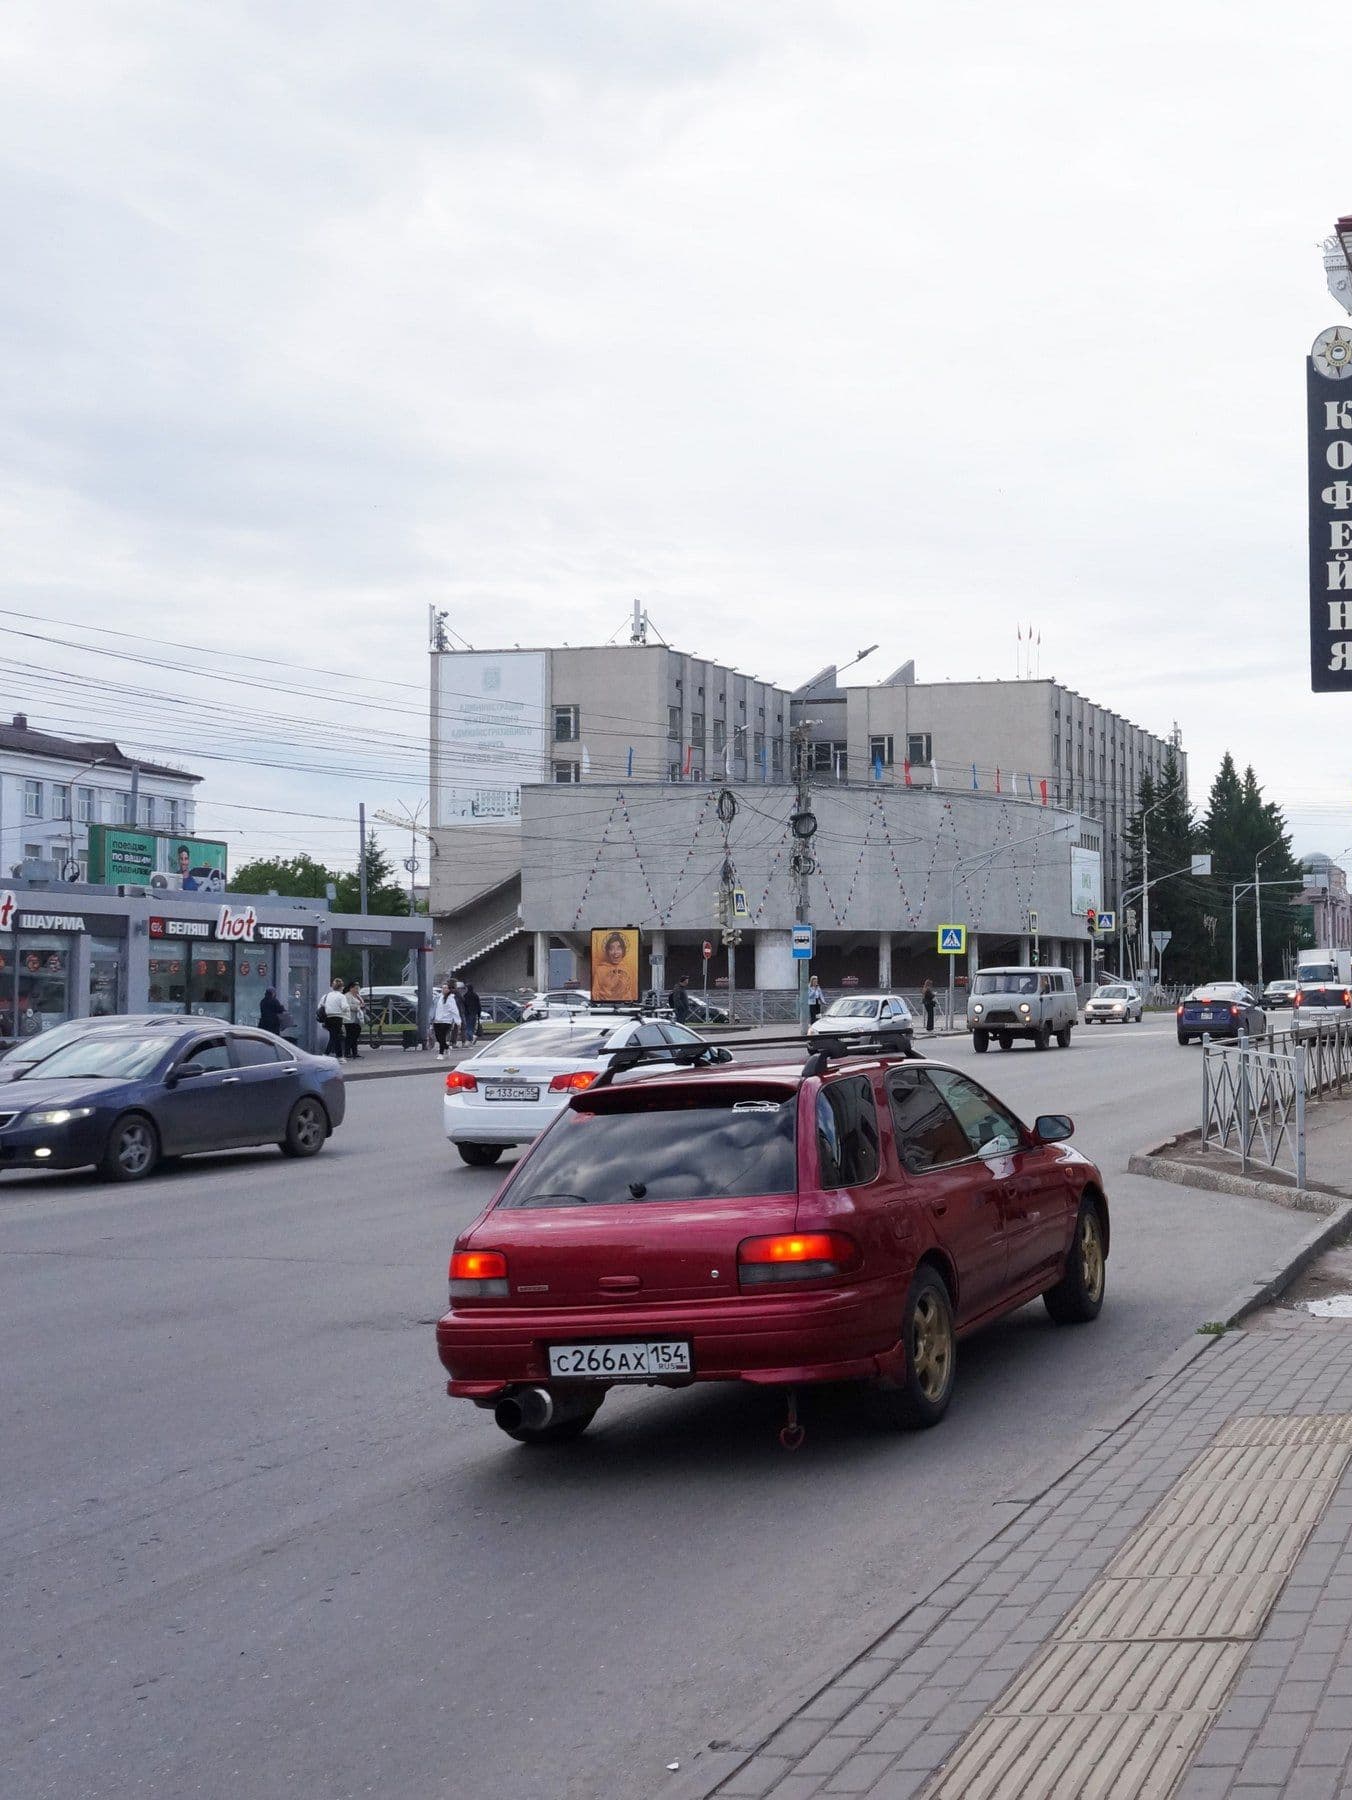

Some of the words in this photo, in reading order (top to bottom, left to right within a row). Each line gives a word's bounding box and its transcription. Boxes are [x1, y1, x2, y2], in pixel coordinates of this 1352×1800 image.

[20, 914, 87, 931] ШАУРМА
[167, 921, 210, 936] БЕЛЯШ
[259, 926, 304, 941] ЧЕБУРЕК
[219, 908, 255, 938] hot
[650, 1345, 685, 1363] 154
[658, 1362, 676, 1370] RUS
